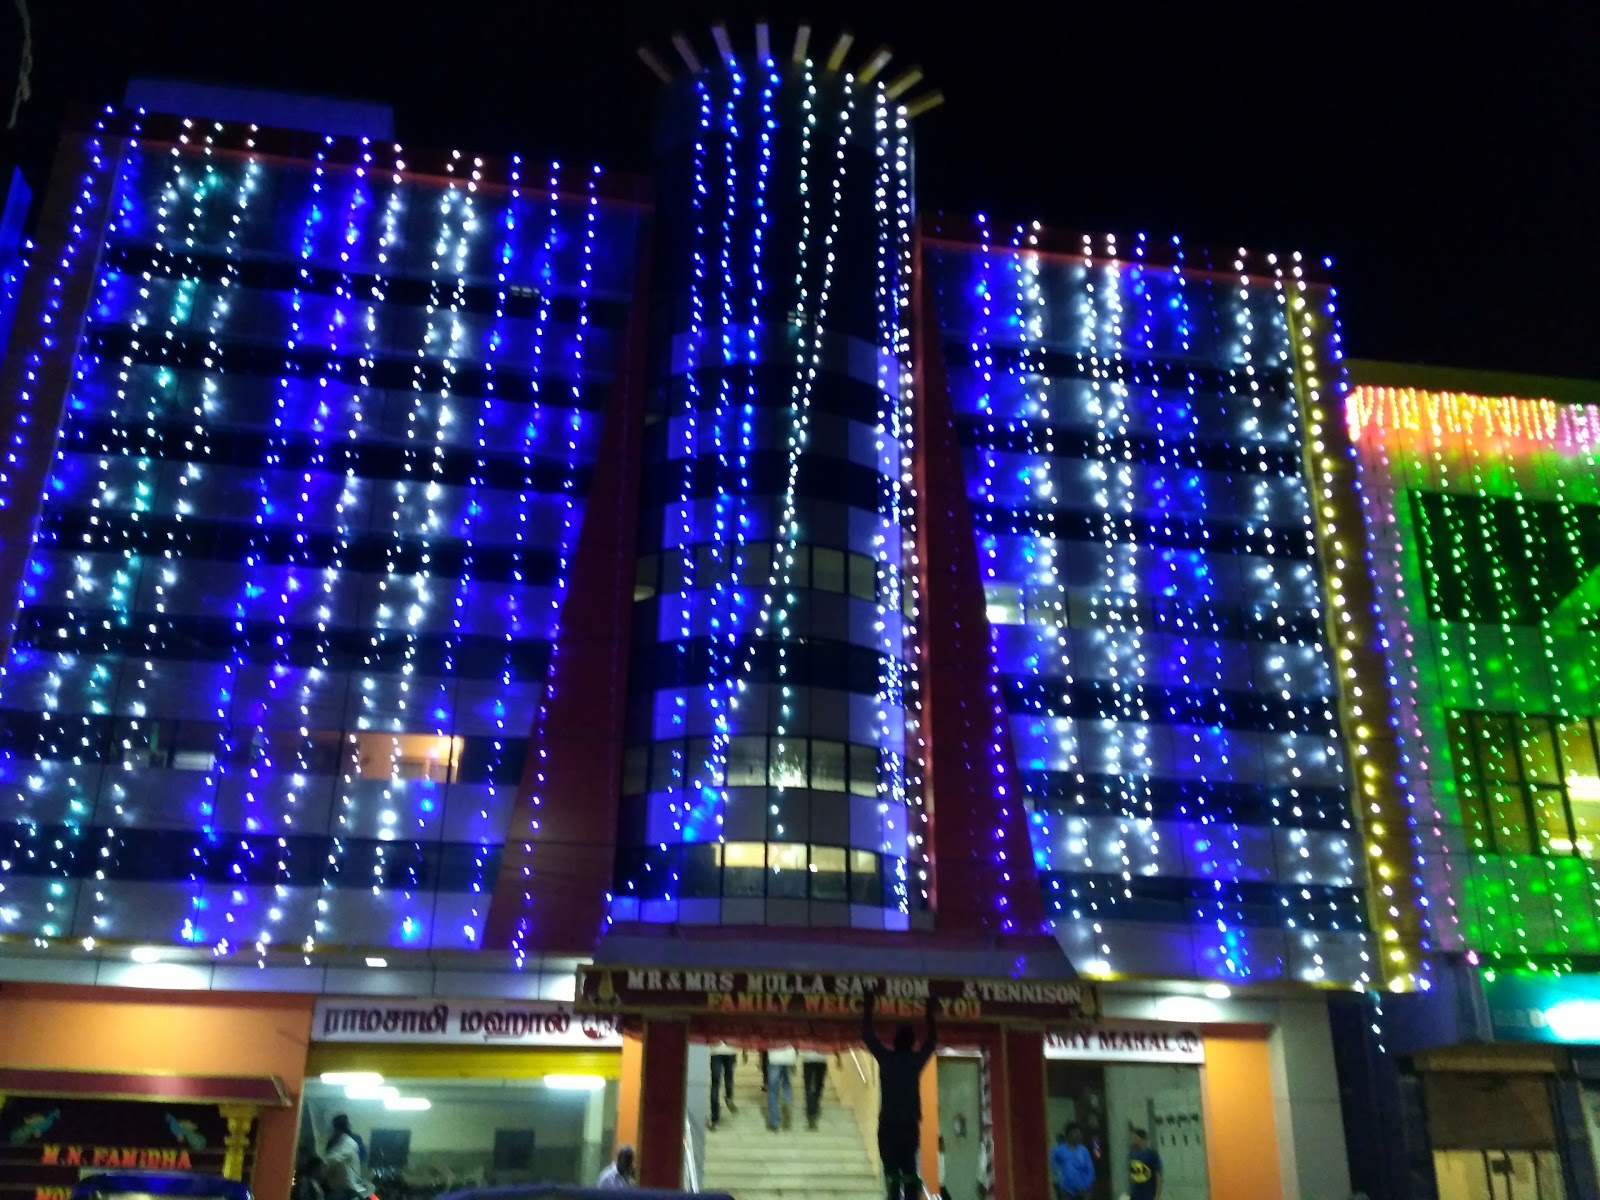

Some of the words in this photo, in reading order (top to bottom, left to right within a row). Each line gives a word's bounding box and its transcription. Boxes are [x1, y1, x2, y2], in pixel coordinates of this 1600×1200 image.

[746, 973, 826, 995] MULLA
[706, 991, 793, 1013] FAMILY
[804, 993, 927, 1017] WELCMES
[937, 997, 981, 1018] YOU
[323, 1004, 449, 1036] ராமசாமி
[1098, 1031, 1176, 1053] MAHAL
